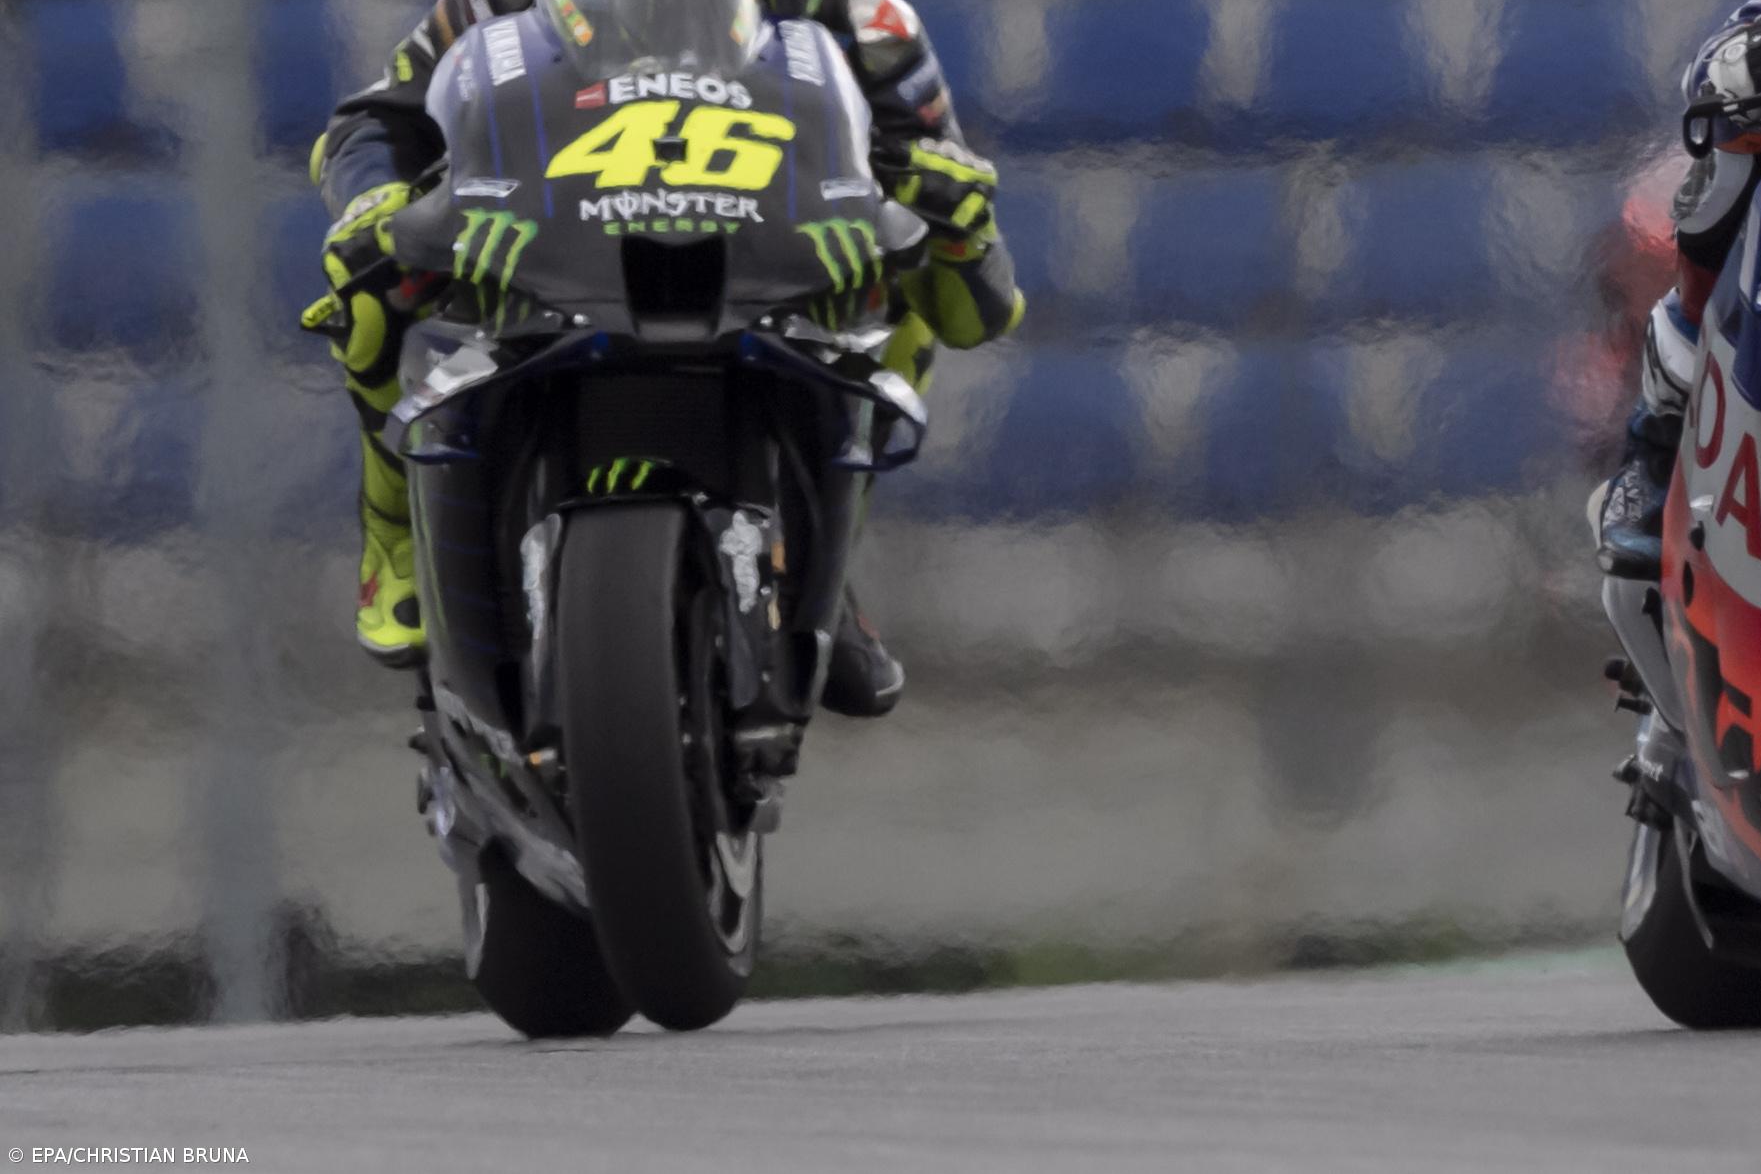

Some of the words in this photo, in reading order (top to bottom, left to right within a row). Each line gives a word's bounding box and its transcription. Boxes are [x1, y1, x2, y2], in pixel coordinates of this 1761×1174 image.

[608, 72, 753, 109] ENEOS
[545, 100, 797, 191] 46
[580, 188, 765, 223] MONSTER
